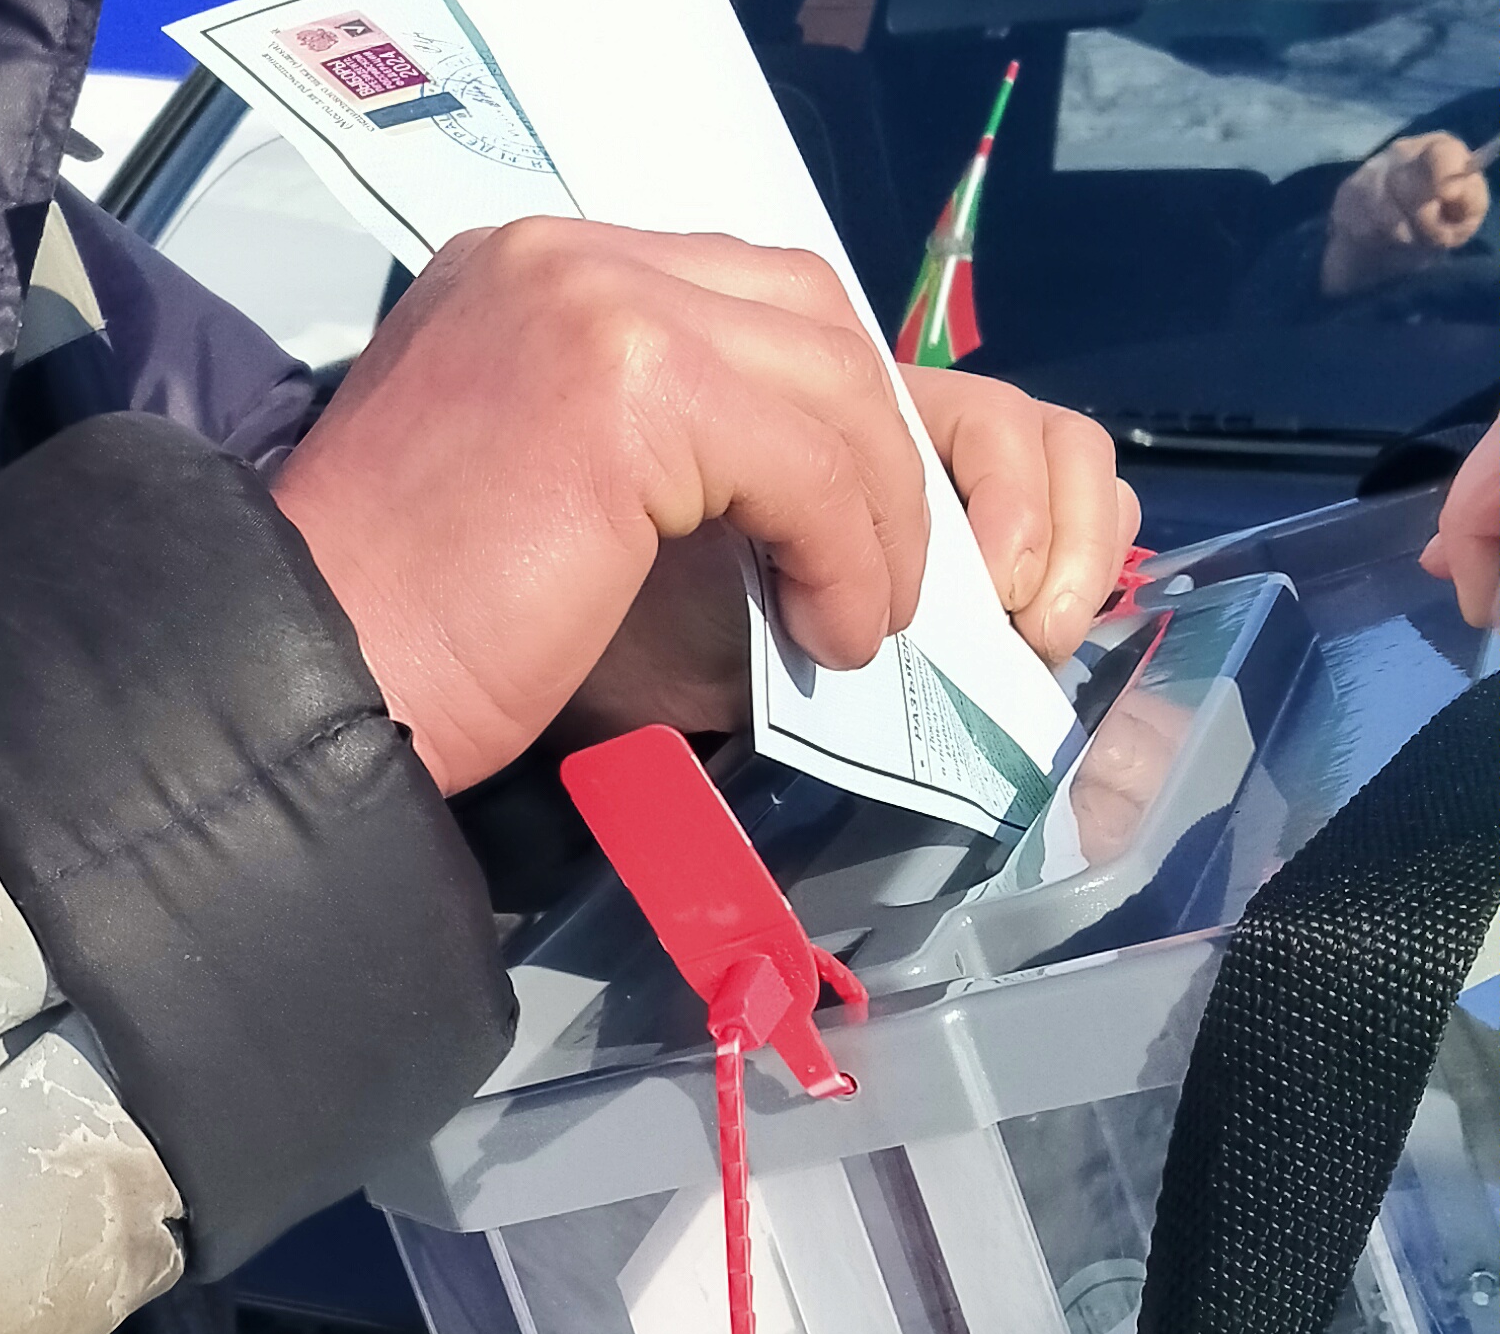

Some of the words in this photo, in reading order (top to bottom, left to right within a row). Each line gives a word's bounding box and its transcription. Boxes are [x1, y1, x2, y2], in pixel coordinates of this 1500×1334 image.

[326, 59, 376, 97] ВЫБОРЫ
[362, 50, 405, 87] ФЕДЕРАЦИИ
[378, 50, 420, 79] 2024
